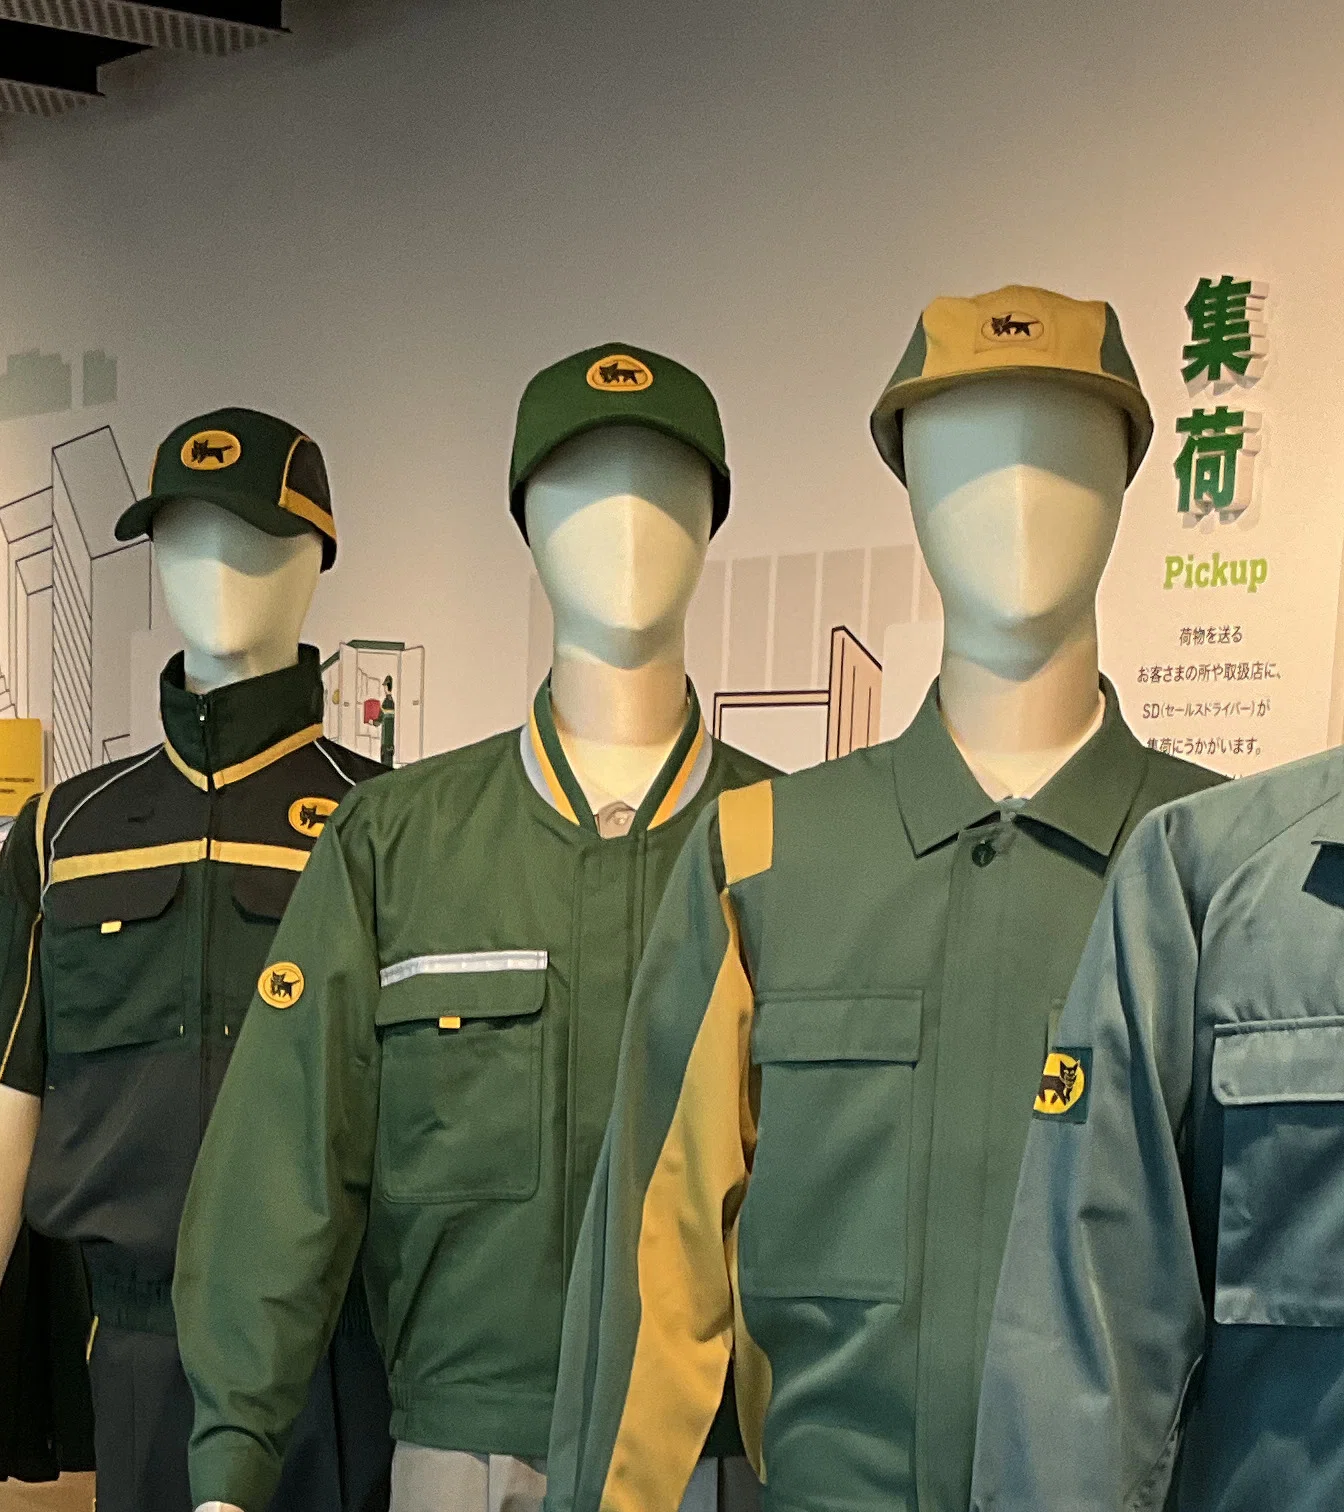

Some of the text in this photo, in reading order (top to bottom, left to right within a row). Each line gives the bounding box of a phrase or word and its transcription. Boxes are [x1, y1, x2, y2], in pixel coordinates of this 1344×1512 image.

[1174, 274, 1253, 514] 集荷
[1164, 553, 1268, 593] Pickup
[1179, 625, 1243, 646] 荷物を送る
[1137, 662, 1282, 683] お客さまの所や取扱店に、
